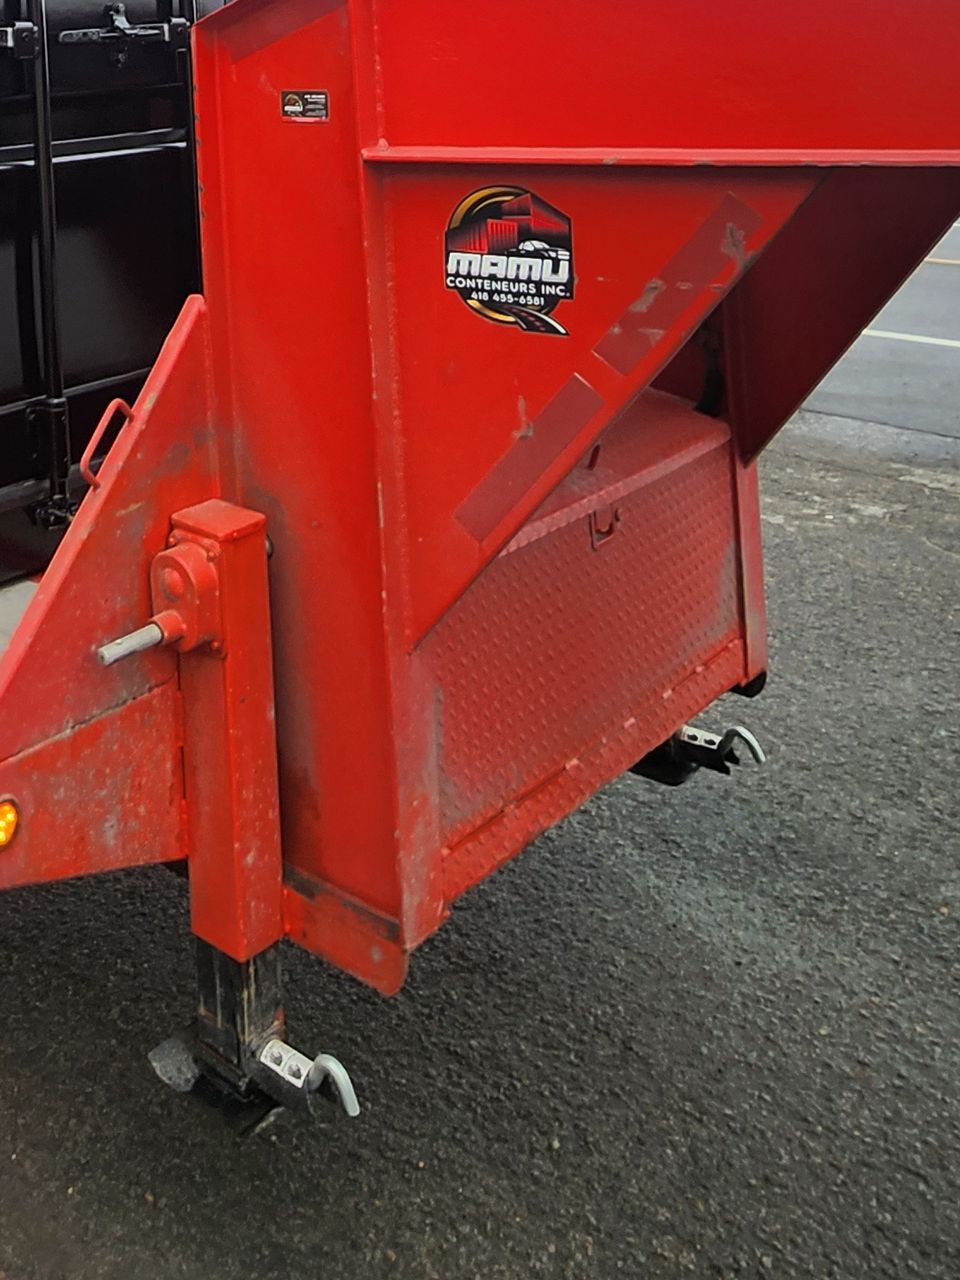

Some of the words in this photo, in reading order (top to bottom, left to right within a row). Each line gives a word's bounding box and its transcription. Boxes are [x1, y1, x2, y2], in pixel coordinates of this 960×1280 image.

[446, 251, 570, 283] MAMU
[446, 276, 537, 294] CONTENEURS
[541, 284, 571, 297] INC.
[470, 291, 489, 301] 418
